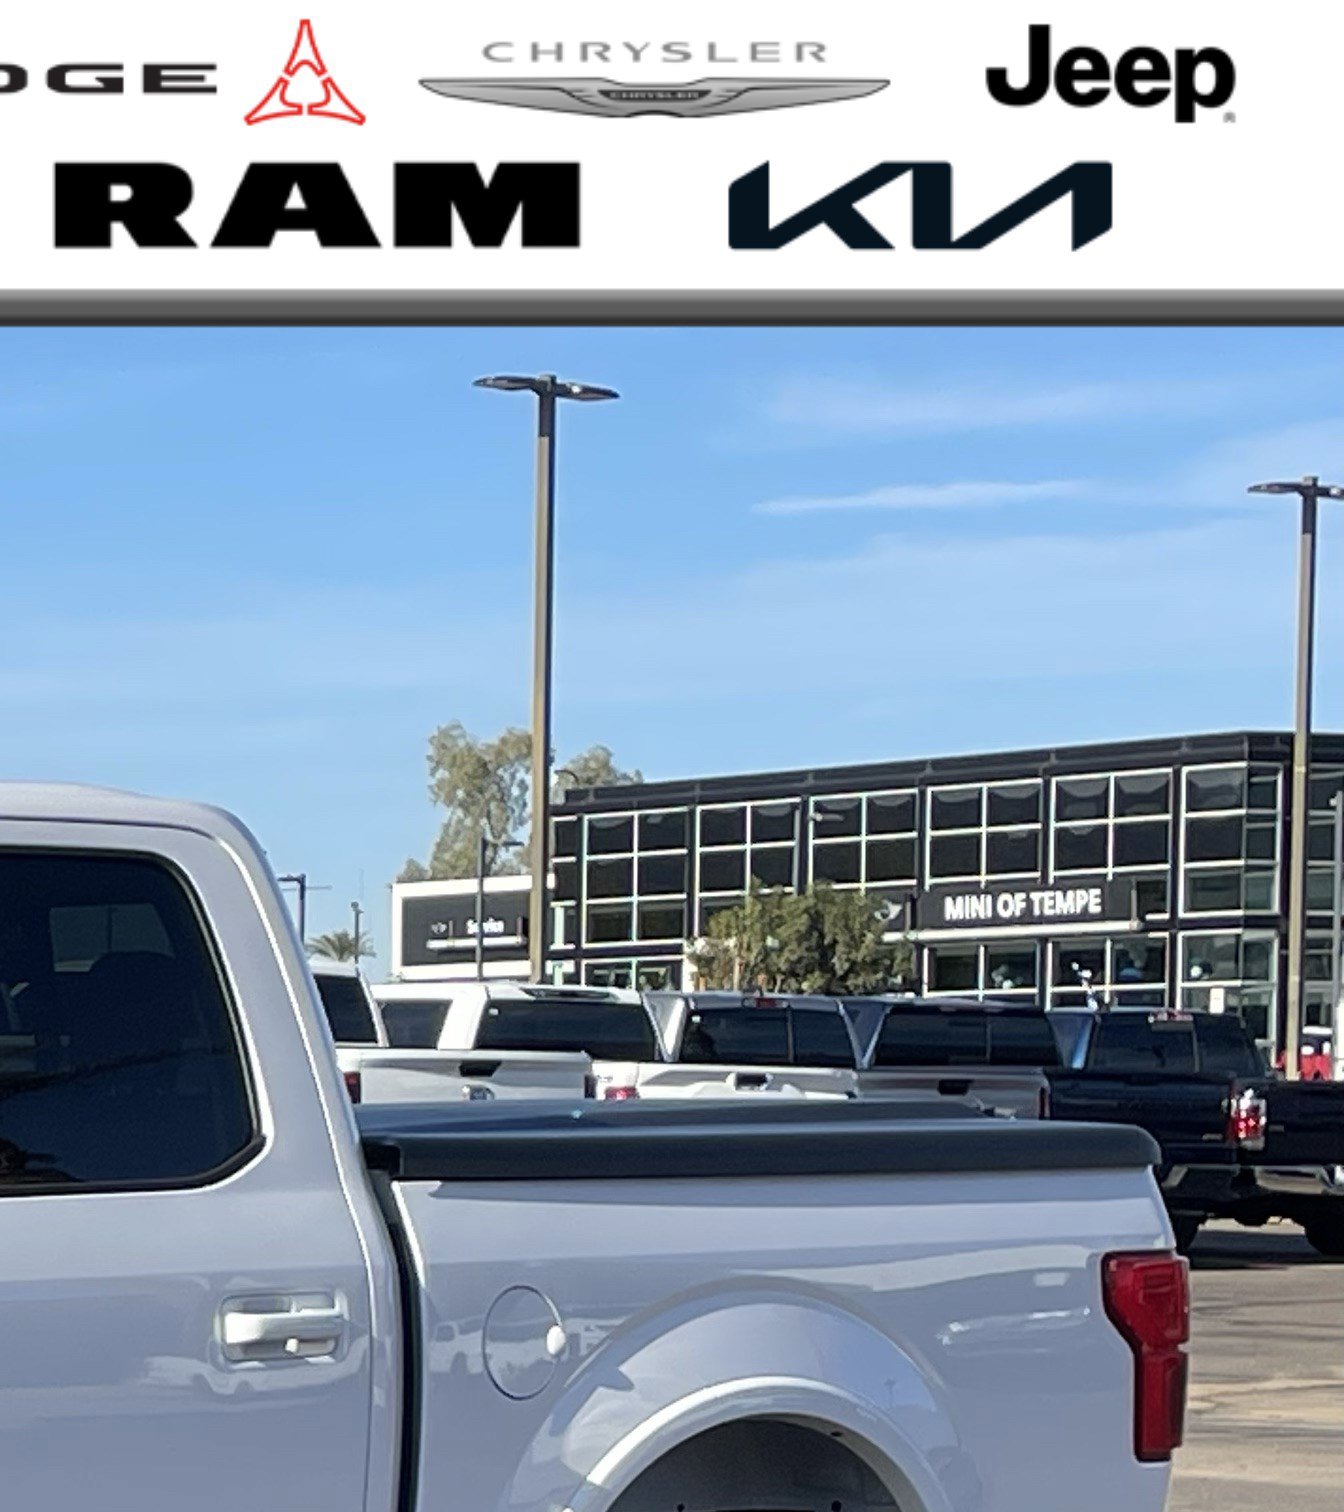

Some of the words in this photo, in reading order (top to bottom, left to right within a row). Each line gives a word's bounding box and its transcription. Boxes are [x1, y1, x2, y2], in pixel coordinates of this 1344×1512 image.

[944, 894, 992, 921] MINI
[997, 891, 1027, 918] OF
[1029, 888, 1102, 917] TEMPE
